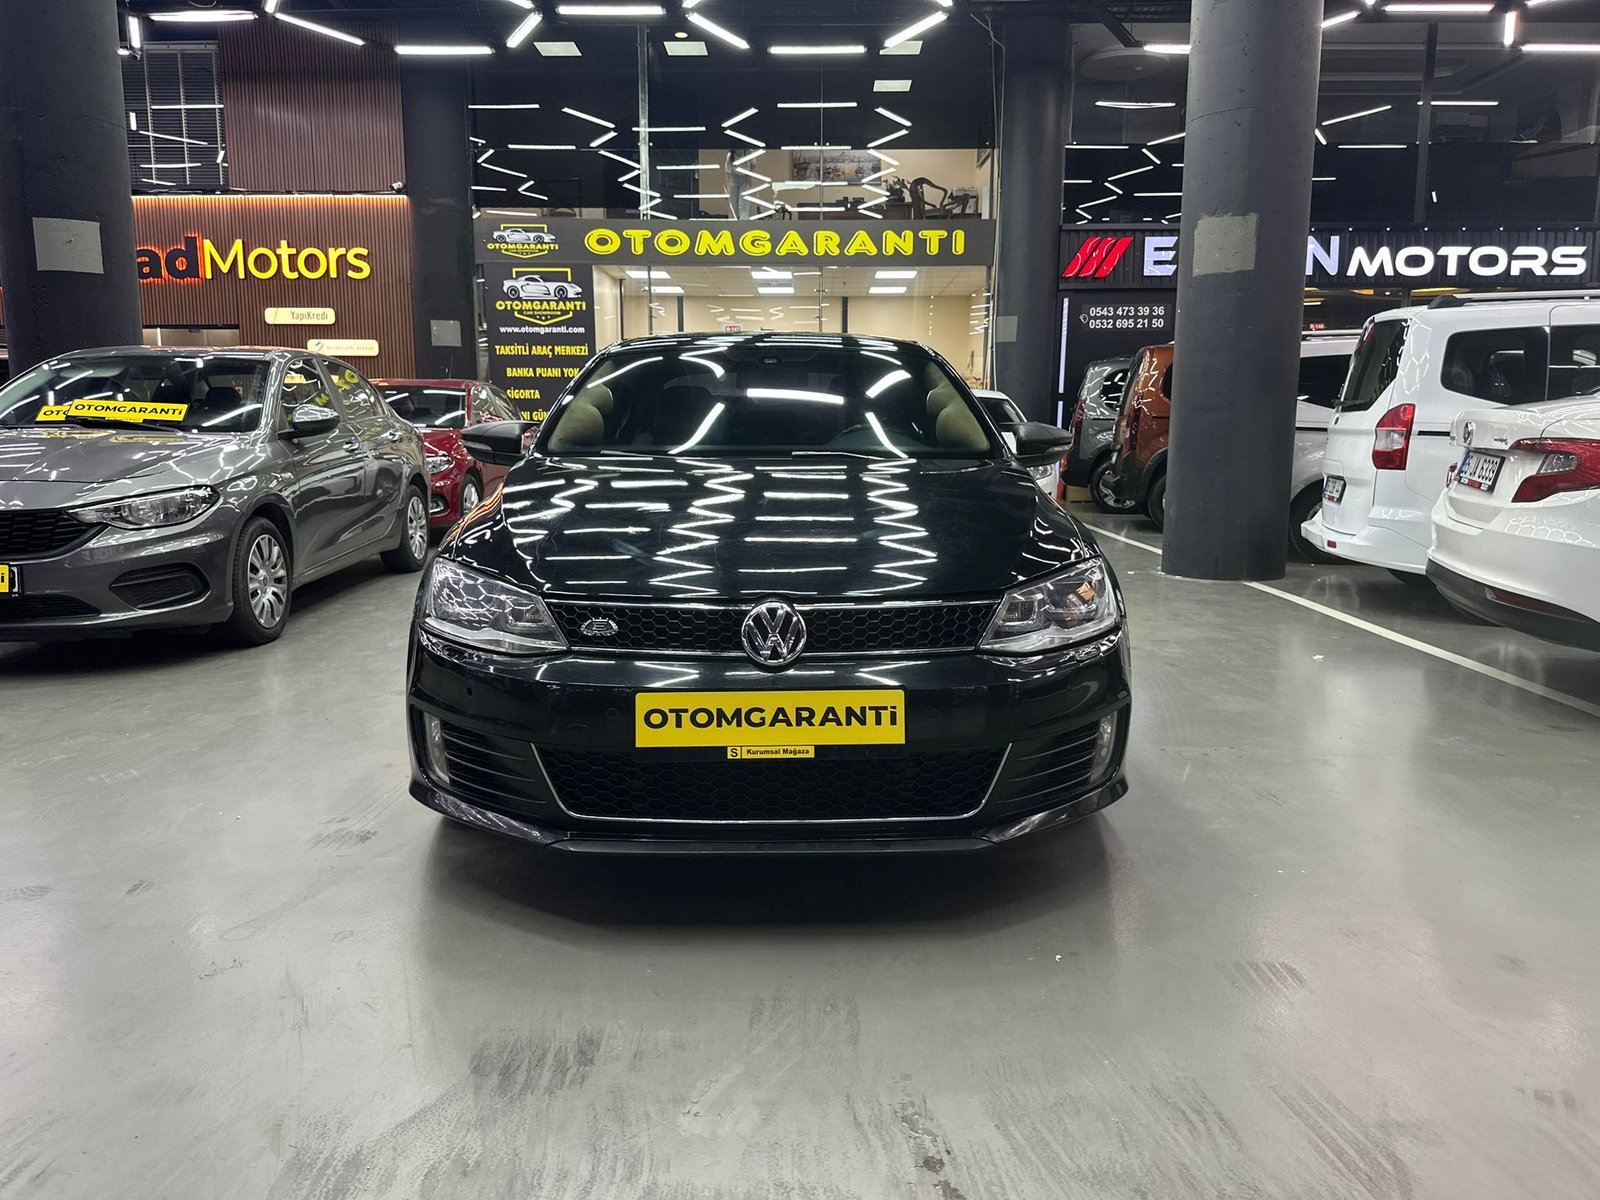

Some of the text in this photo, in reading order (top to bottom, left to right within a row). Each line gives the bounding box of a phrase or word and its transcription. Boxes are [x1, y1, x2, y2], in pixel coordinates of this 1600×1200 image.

[584, 228, 965, 257] OTOMGARANTI
[1345, 245, 1588, 277] MOTORS
[495, 301, 587, 311] OTOMGARANTI
[1089, 306, 1165, 317] 0543 473 39 36
[1089, 318, 1164, 329] 0532 695 21 50
[499, 325, 585, 335] www.otomgaranti.com
[495, 343, 589, 358] TAKSİTLİ ARAÇ MERKEZİ
[506, 367, 580, 378] BANKA PUANI YOK
[506, 387, 541, 399] SİGORTA
[643, 705, 898, 730] OTOMGARANTi
[730, 748, 739, 758] S
[782, 748, 810, 756] Mağaza
